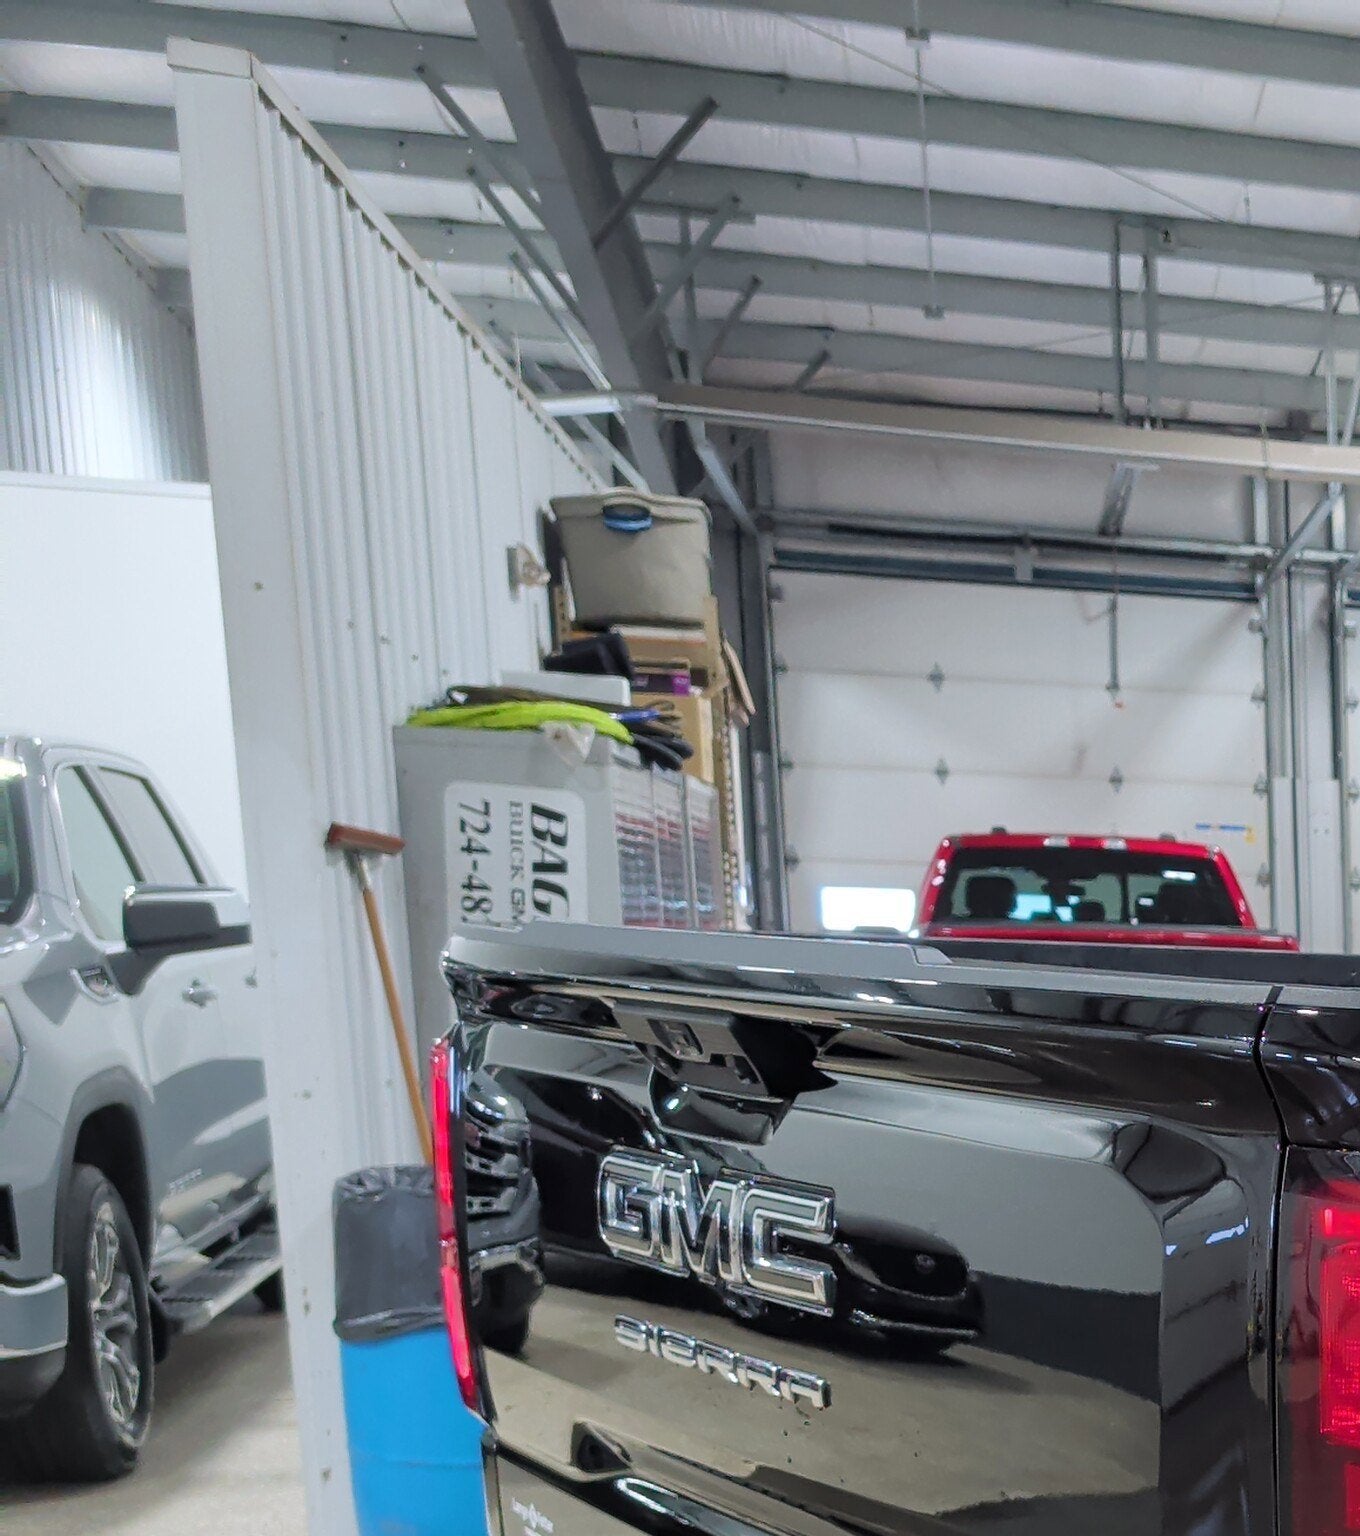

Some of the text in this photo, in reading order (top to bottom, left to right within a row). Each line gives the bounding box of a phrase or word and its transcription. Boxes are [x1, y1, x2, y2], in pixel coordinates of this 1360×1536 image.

[458, 798, 493, 922] 724-48
[509, 801, 524, 880] BUICK
[597, 1144, 839, 1318] GMC
[613, 1313, 838, 1411] SIERRA
